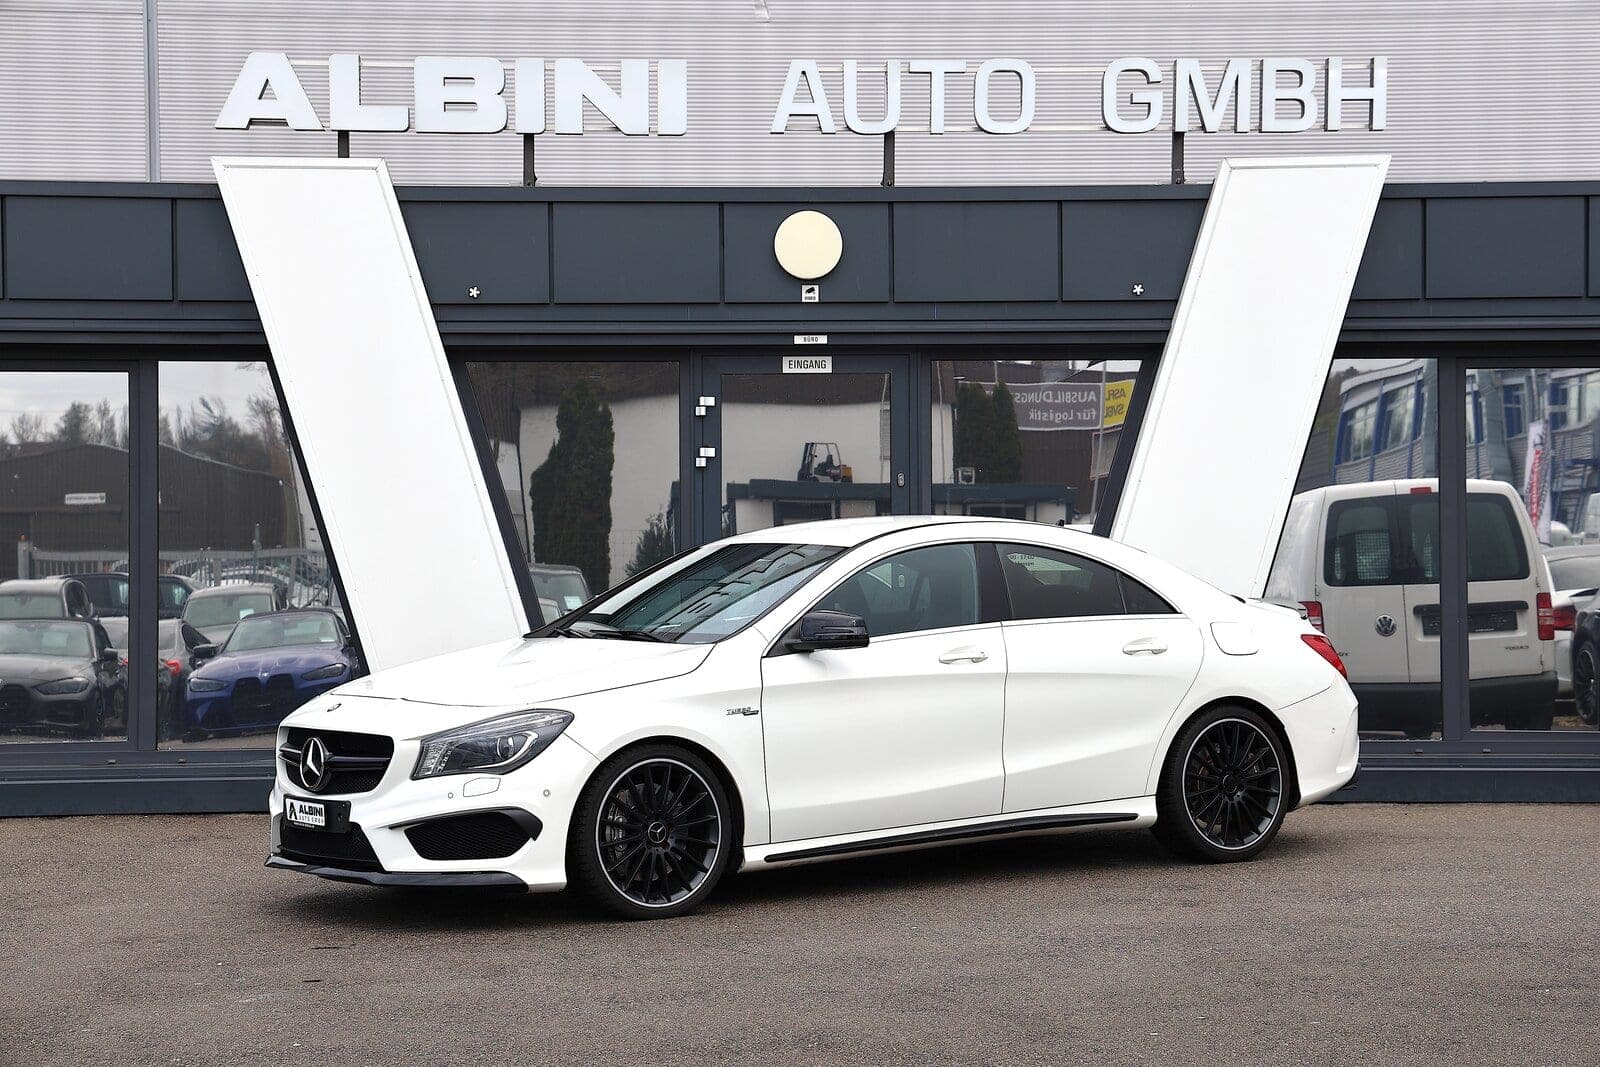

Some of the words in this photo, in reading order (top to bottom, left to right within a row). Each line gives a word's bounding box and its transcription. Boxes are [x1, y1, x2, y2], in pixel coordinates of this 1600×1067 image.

[215, 52, 688, 136] ALBINI
[770, 58, 1036, 135] AUTO
[1101, 56, 1388, 133] GMBH
[788, 359, 827, 369] EINGANG
[299, 804, 323, 816] ALBINI
